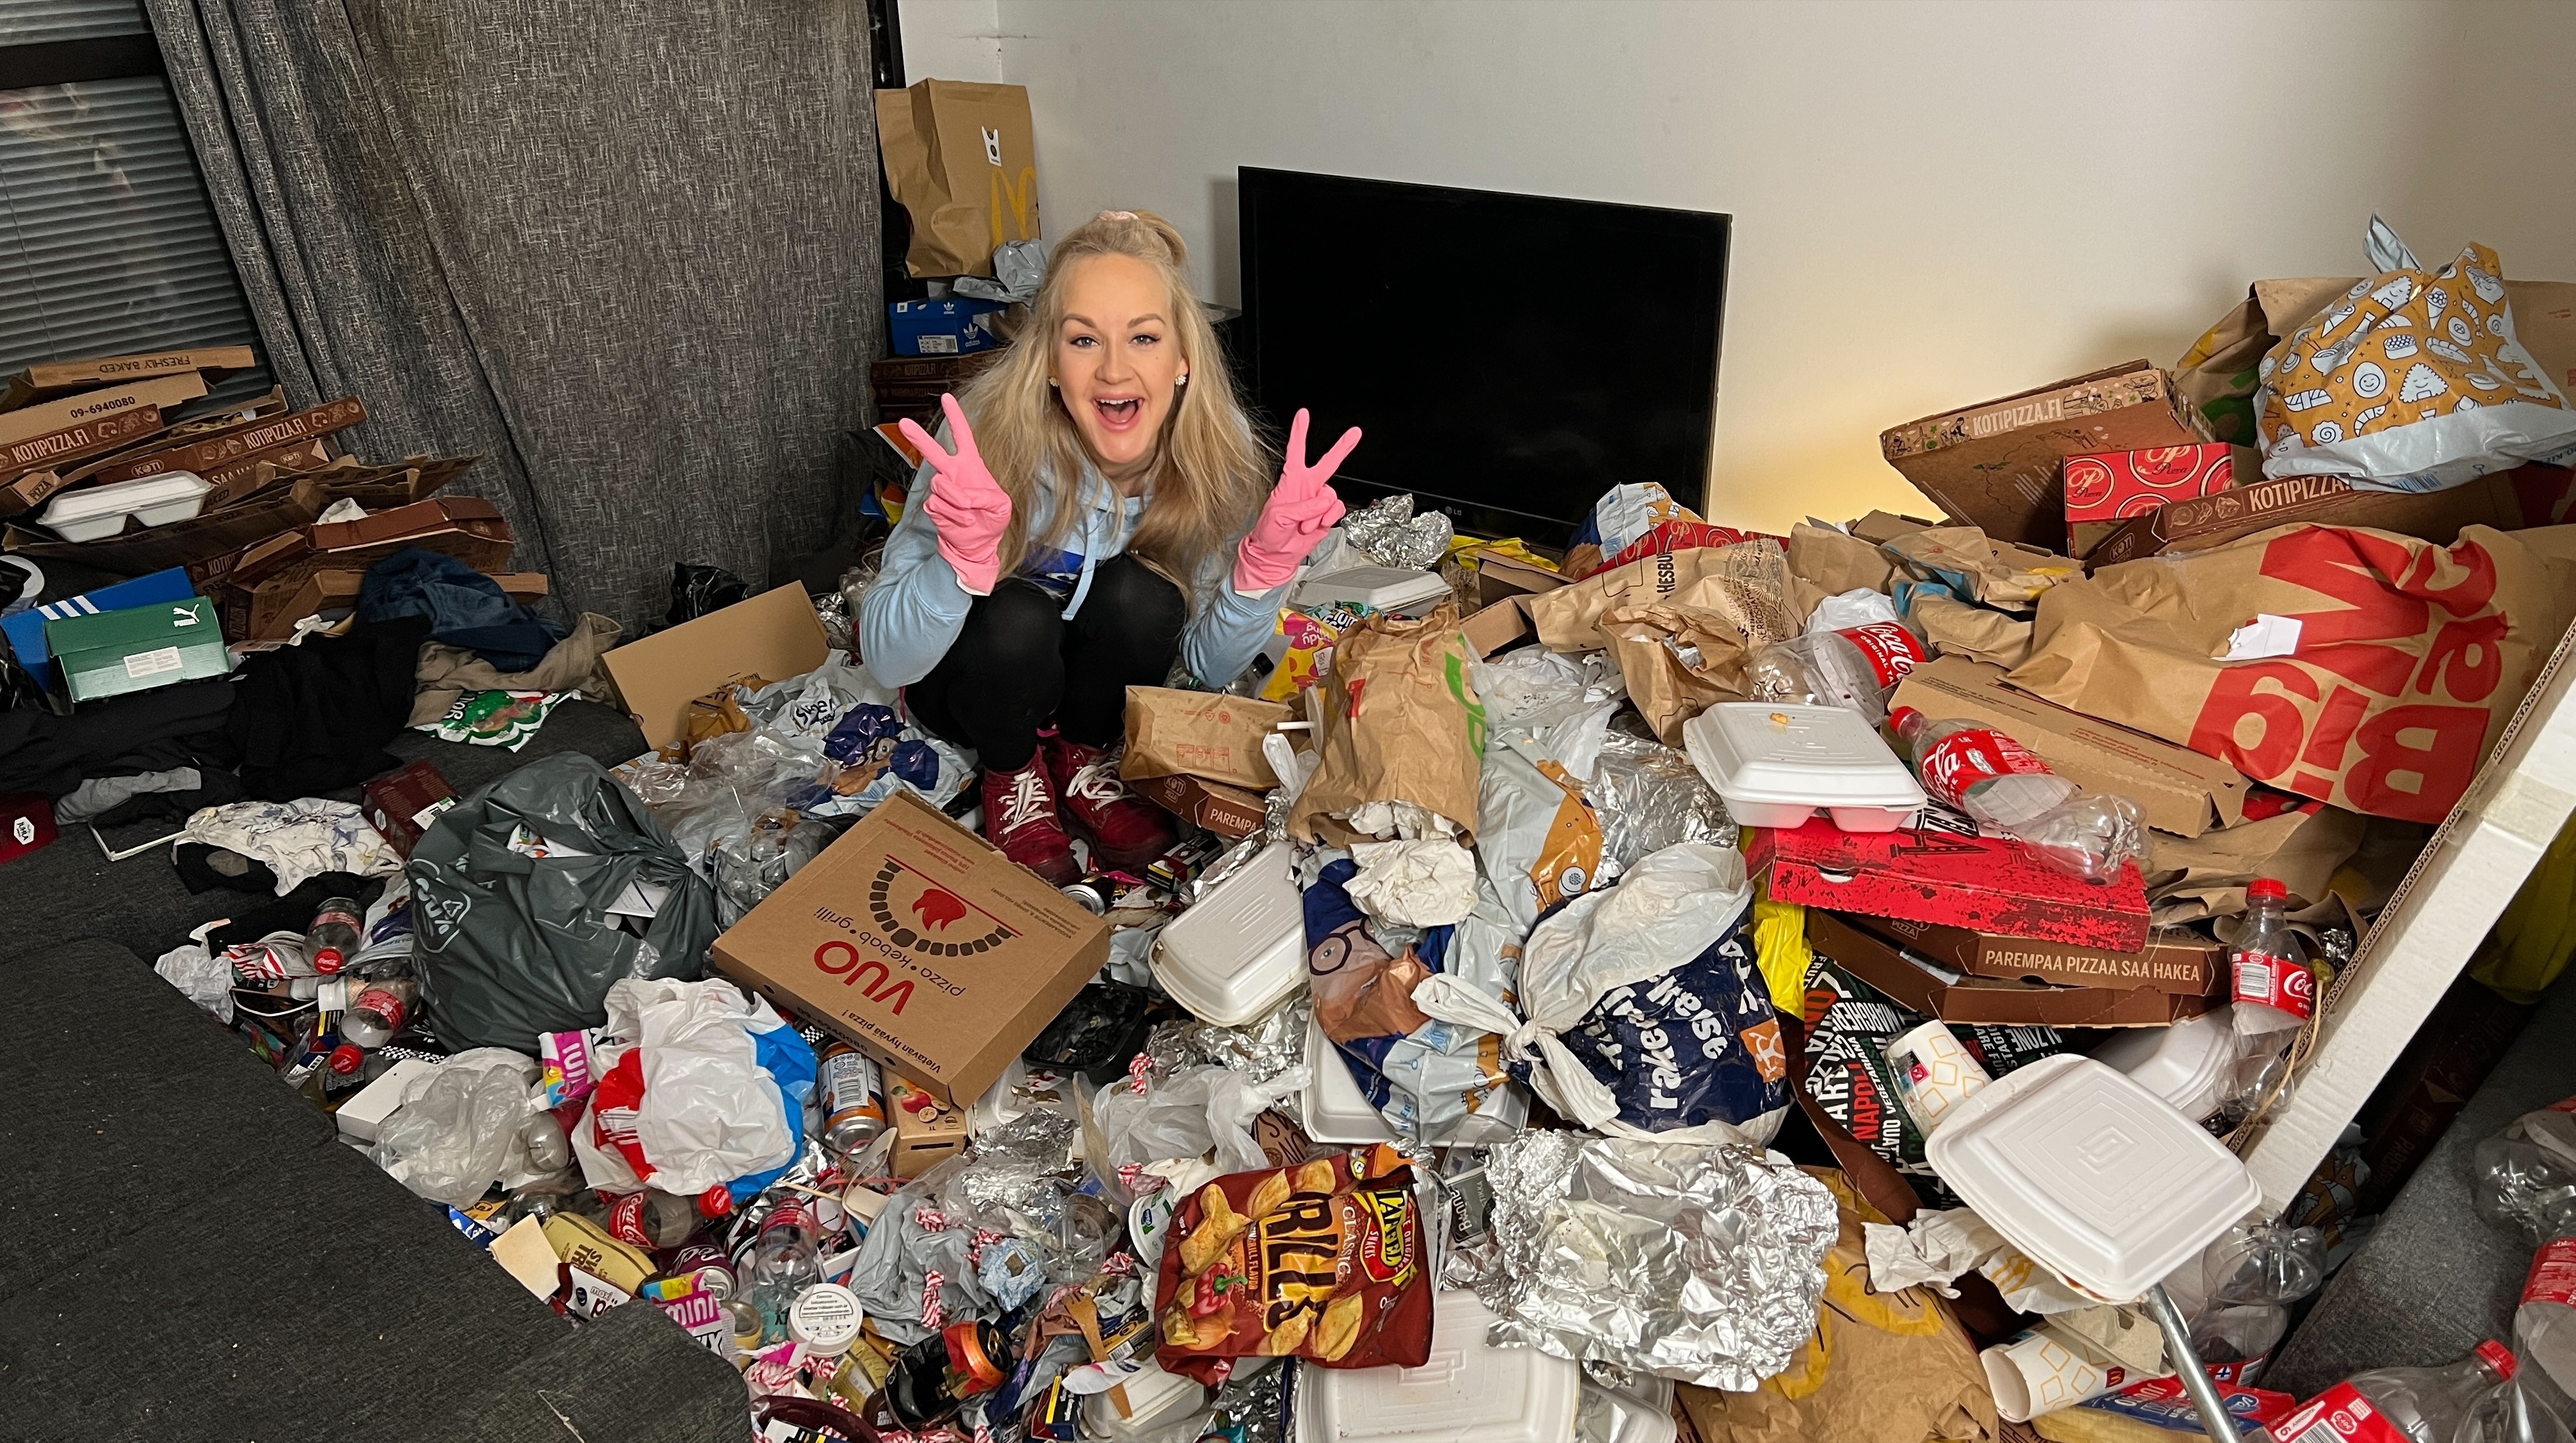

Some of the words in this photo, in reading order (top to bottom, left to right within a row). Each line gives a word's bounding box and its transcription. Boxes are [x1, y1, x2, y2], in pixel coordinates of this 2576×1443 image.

[99, 359, 142, 373] BAKED
[144, 355, 190, 369] FRESHLY
[70, 396, 136, 419] 09-6940080
[1972, 397, 2062, 436] KOTIPIZZA.FI
[12, 429, 90, 464] KOTIPIZZA.FI
[243, 418, 307, 450] KOTIPIZZA.FI
[135, 461, 162, 475] KOTI
[2250, 476, 2351, 513] KOTIPIZZA.
[2111, 534, 2135, 559] KOTI
[1860, 635, 1890, 675] ORIGINAL
[2186, 661, 2490, 824] Big
[1165, 775, 1184, 794] KOTI
[1209, 808, 1263, 833] PAREMPA
[1892, 920, 1917, 937] PIZZA
[813, 941, 915, 1016] VUO
[1986, 950, 2063, 971] PAREMPAA
[2066, 957, 2118, 976] PIZZAA
[2122, 960, 2150, 978] SAA
[2153, 962, 2200, 982] HAKEA
[797, 1006, 869, 1053] 09-6940080
[848, 1010, 875, 1033] pizza
[1850, 1037, 1896, 1116] VEGETARIANA
[1853, 1063, 1880, 1141] NAPOLI
[1337, 1205, 1357, 1276] CLASSIC
[1375, 1189, 1408, 1265] TAFFEL
[1363, 1230, 1380, 1260] SNACKS
[590, 1286, 615, 1301] maxi
[665, 1293, 715, 1327] mini
